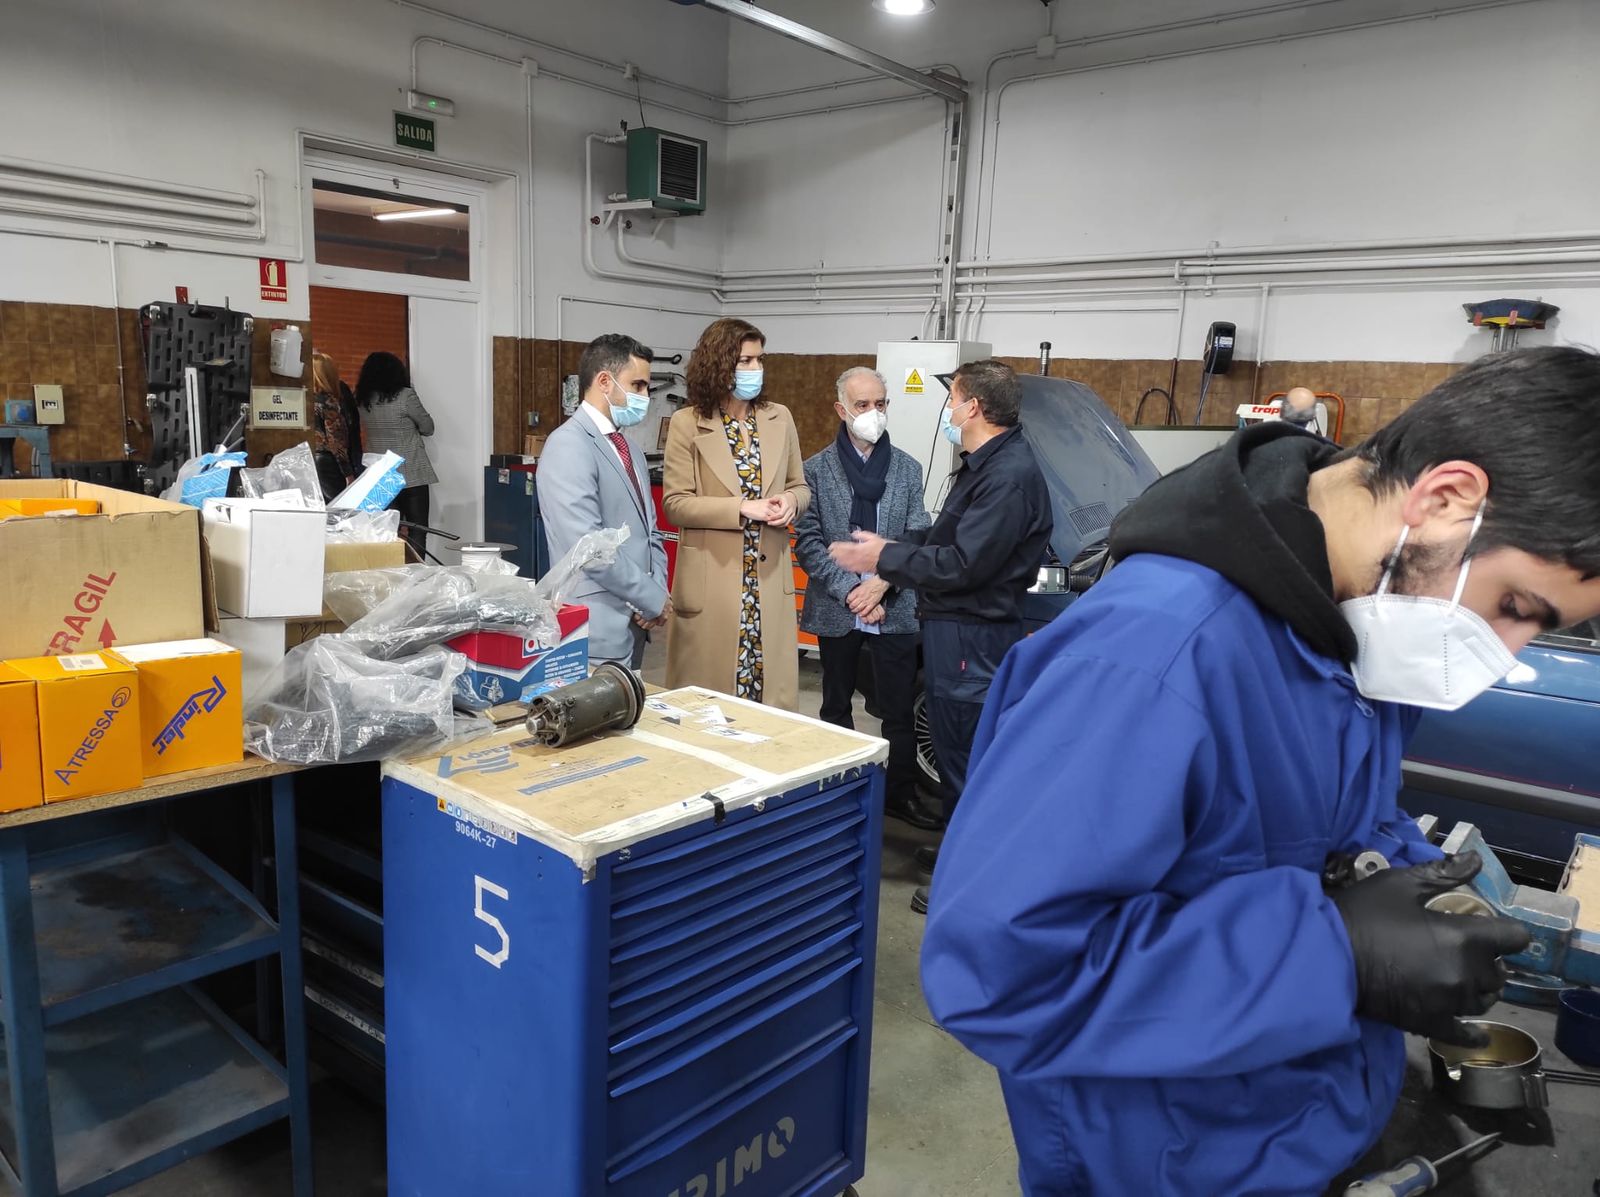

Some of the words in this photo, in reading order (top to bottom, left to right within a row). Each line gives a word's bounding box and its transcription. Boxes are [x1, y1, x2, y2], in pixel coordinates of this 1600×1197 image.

[397, 122, 433, 143] SALIDA
[261, 290, 287, 299] EXTINTOR
[272, 394, 283, 404] GEL
[258, 410, 299, 421] DESINFECTANTE
[54, 708, 120, 786] ATRESSA
[455, 820, 497, 849] 9064K-27
[473, 874, 510, 970] 5
